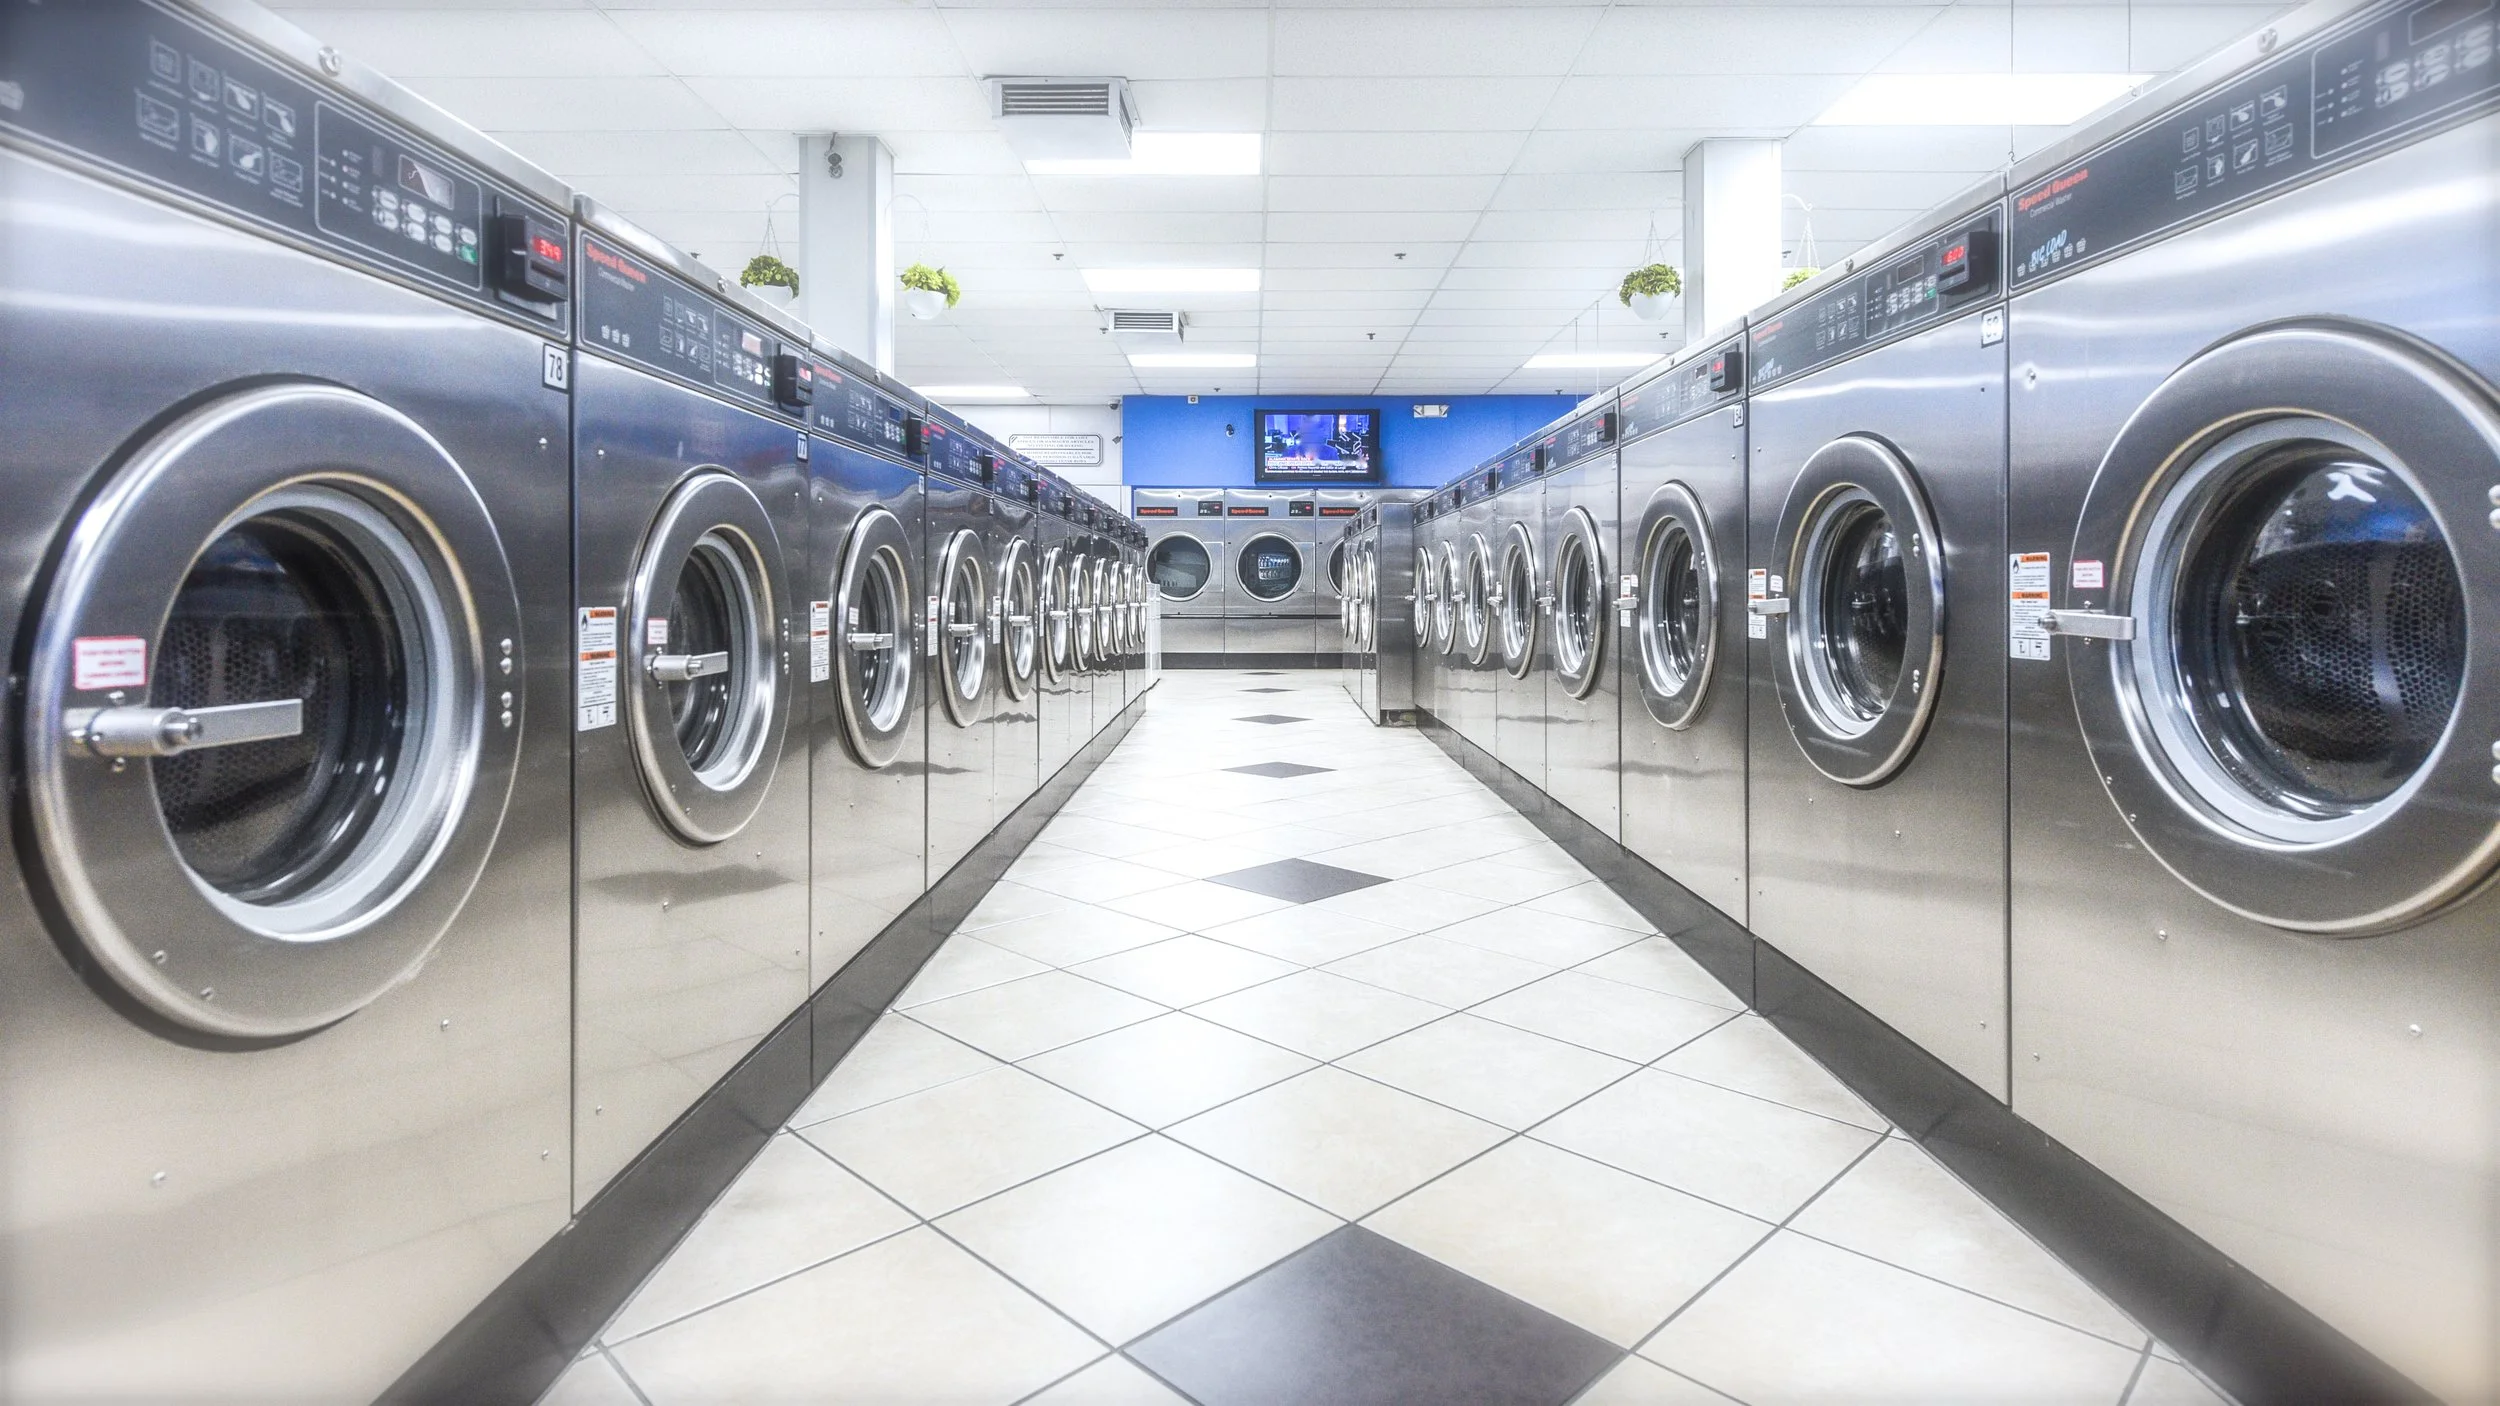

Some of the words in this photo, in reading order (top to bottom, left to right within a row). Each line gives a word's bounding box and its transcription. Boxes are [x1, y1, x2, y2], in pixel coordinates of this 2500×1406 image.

[2018, 184, 2051, 212] Speed
[2052, 168, 2088, 194] Queen
[586, 242, 617, 269] Speed
[617, 257, 647, 283] Queen
[549, 353, 563, 381] 78
